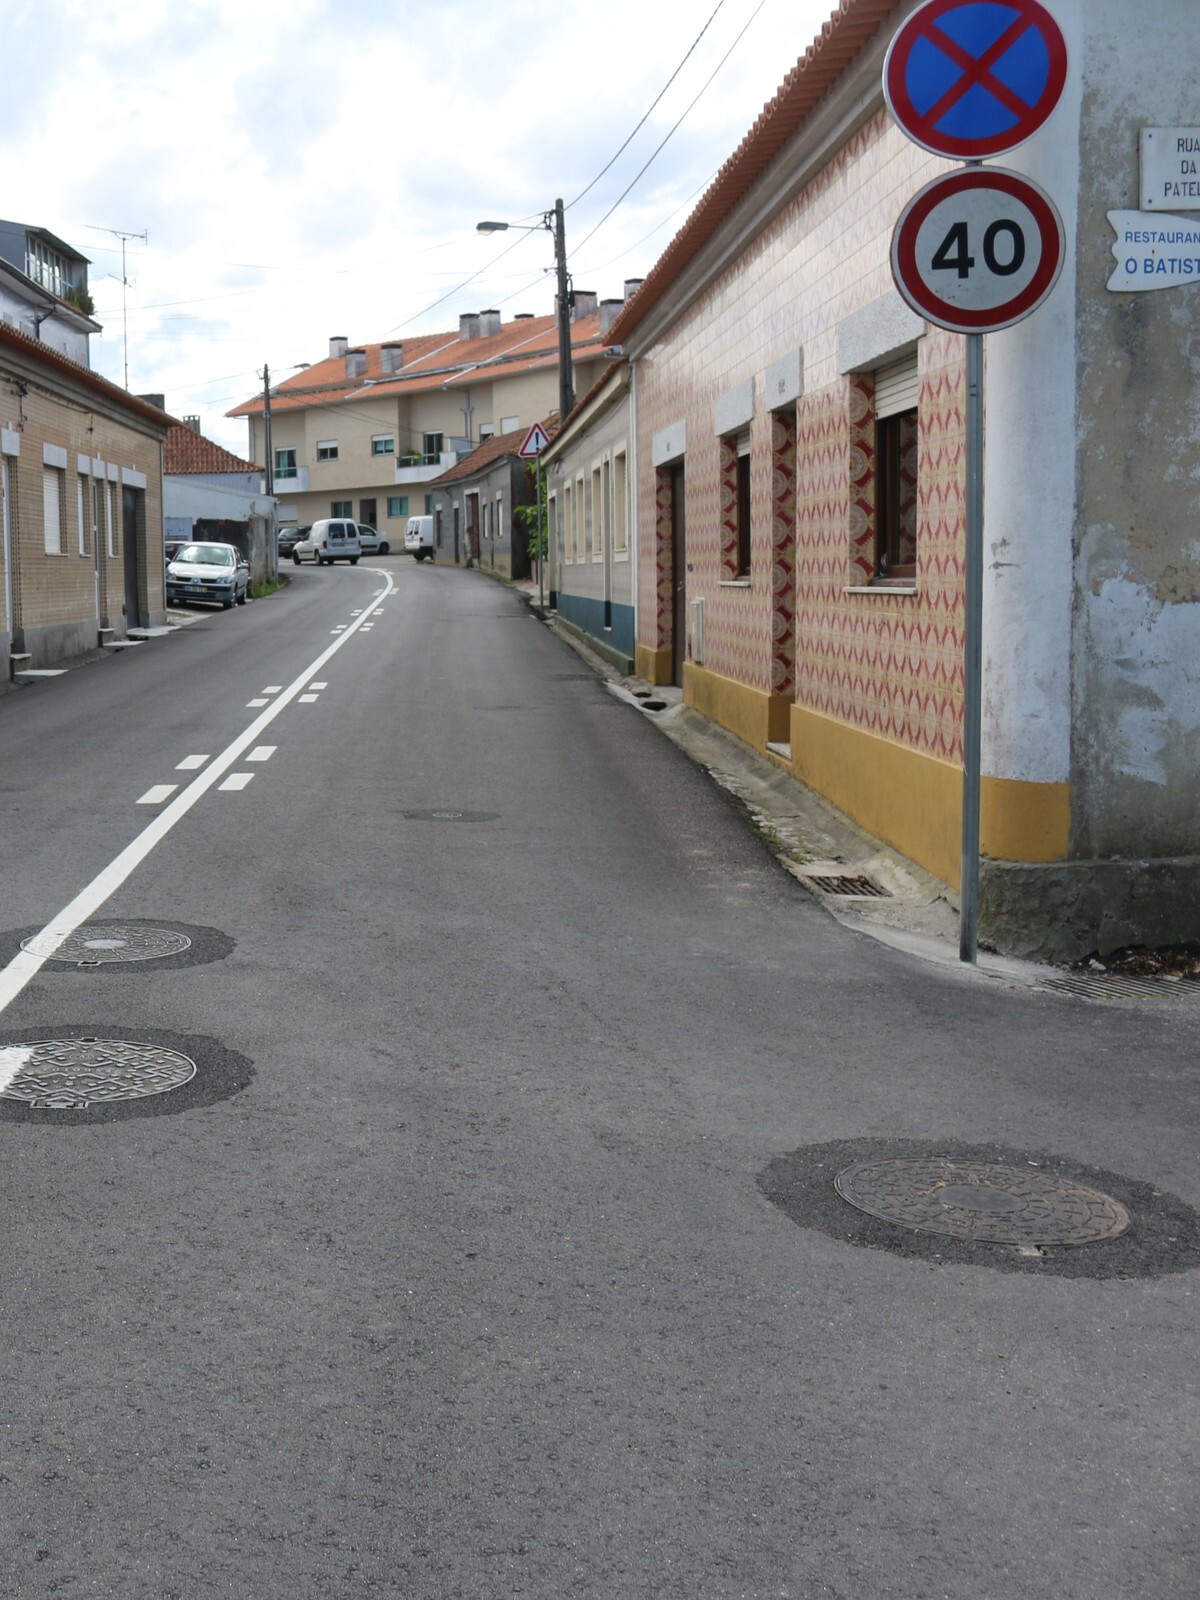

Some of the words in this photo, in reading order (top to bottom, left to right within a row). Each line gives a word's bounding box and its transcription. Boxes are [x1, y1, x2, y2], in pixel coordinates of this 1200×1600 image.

[1177, 138, 1200, 152] RUA
[1181, 160, 1197, 174] DA
[1125, 231, 1200, 243] RESTAURAN
[931, 219, 1025, 278] 40
[1125, 258, 1138, 274] O
[1144, 258, 1200, 274] BATIST
